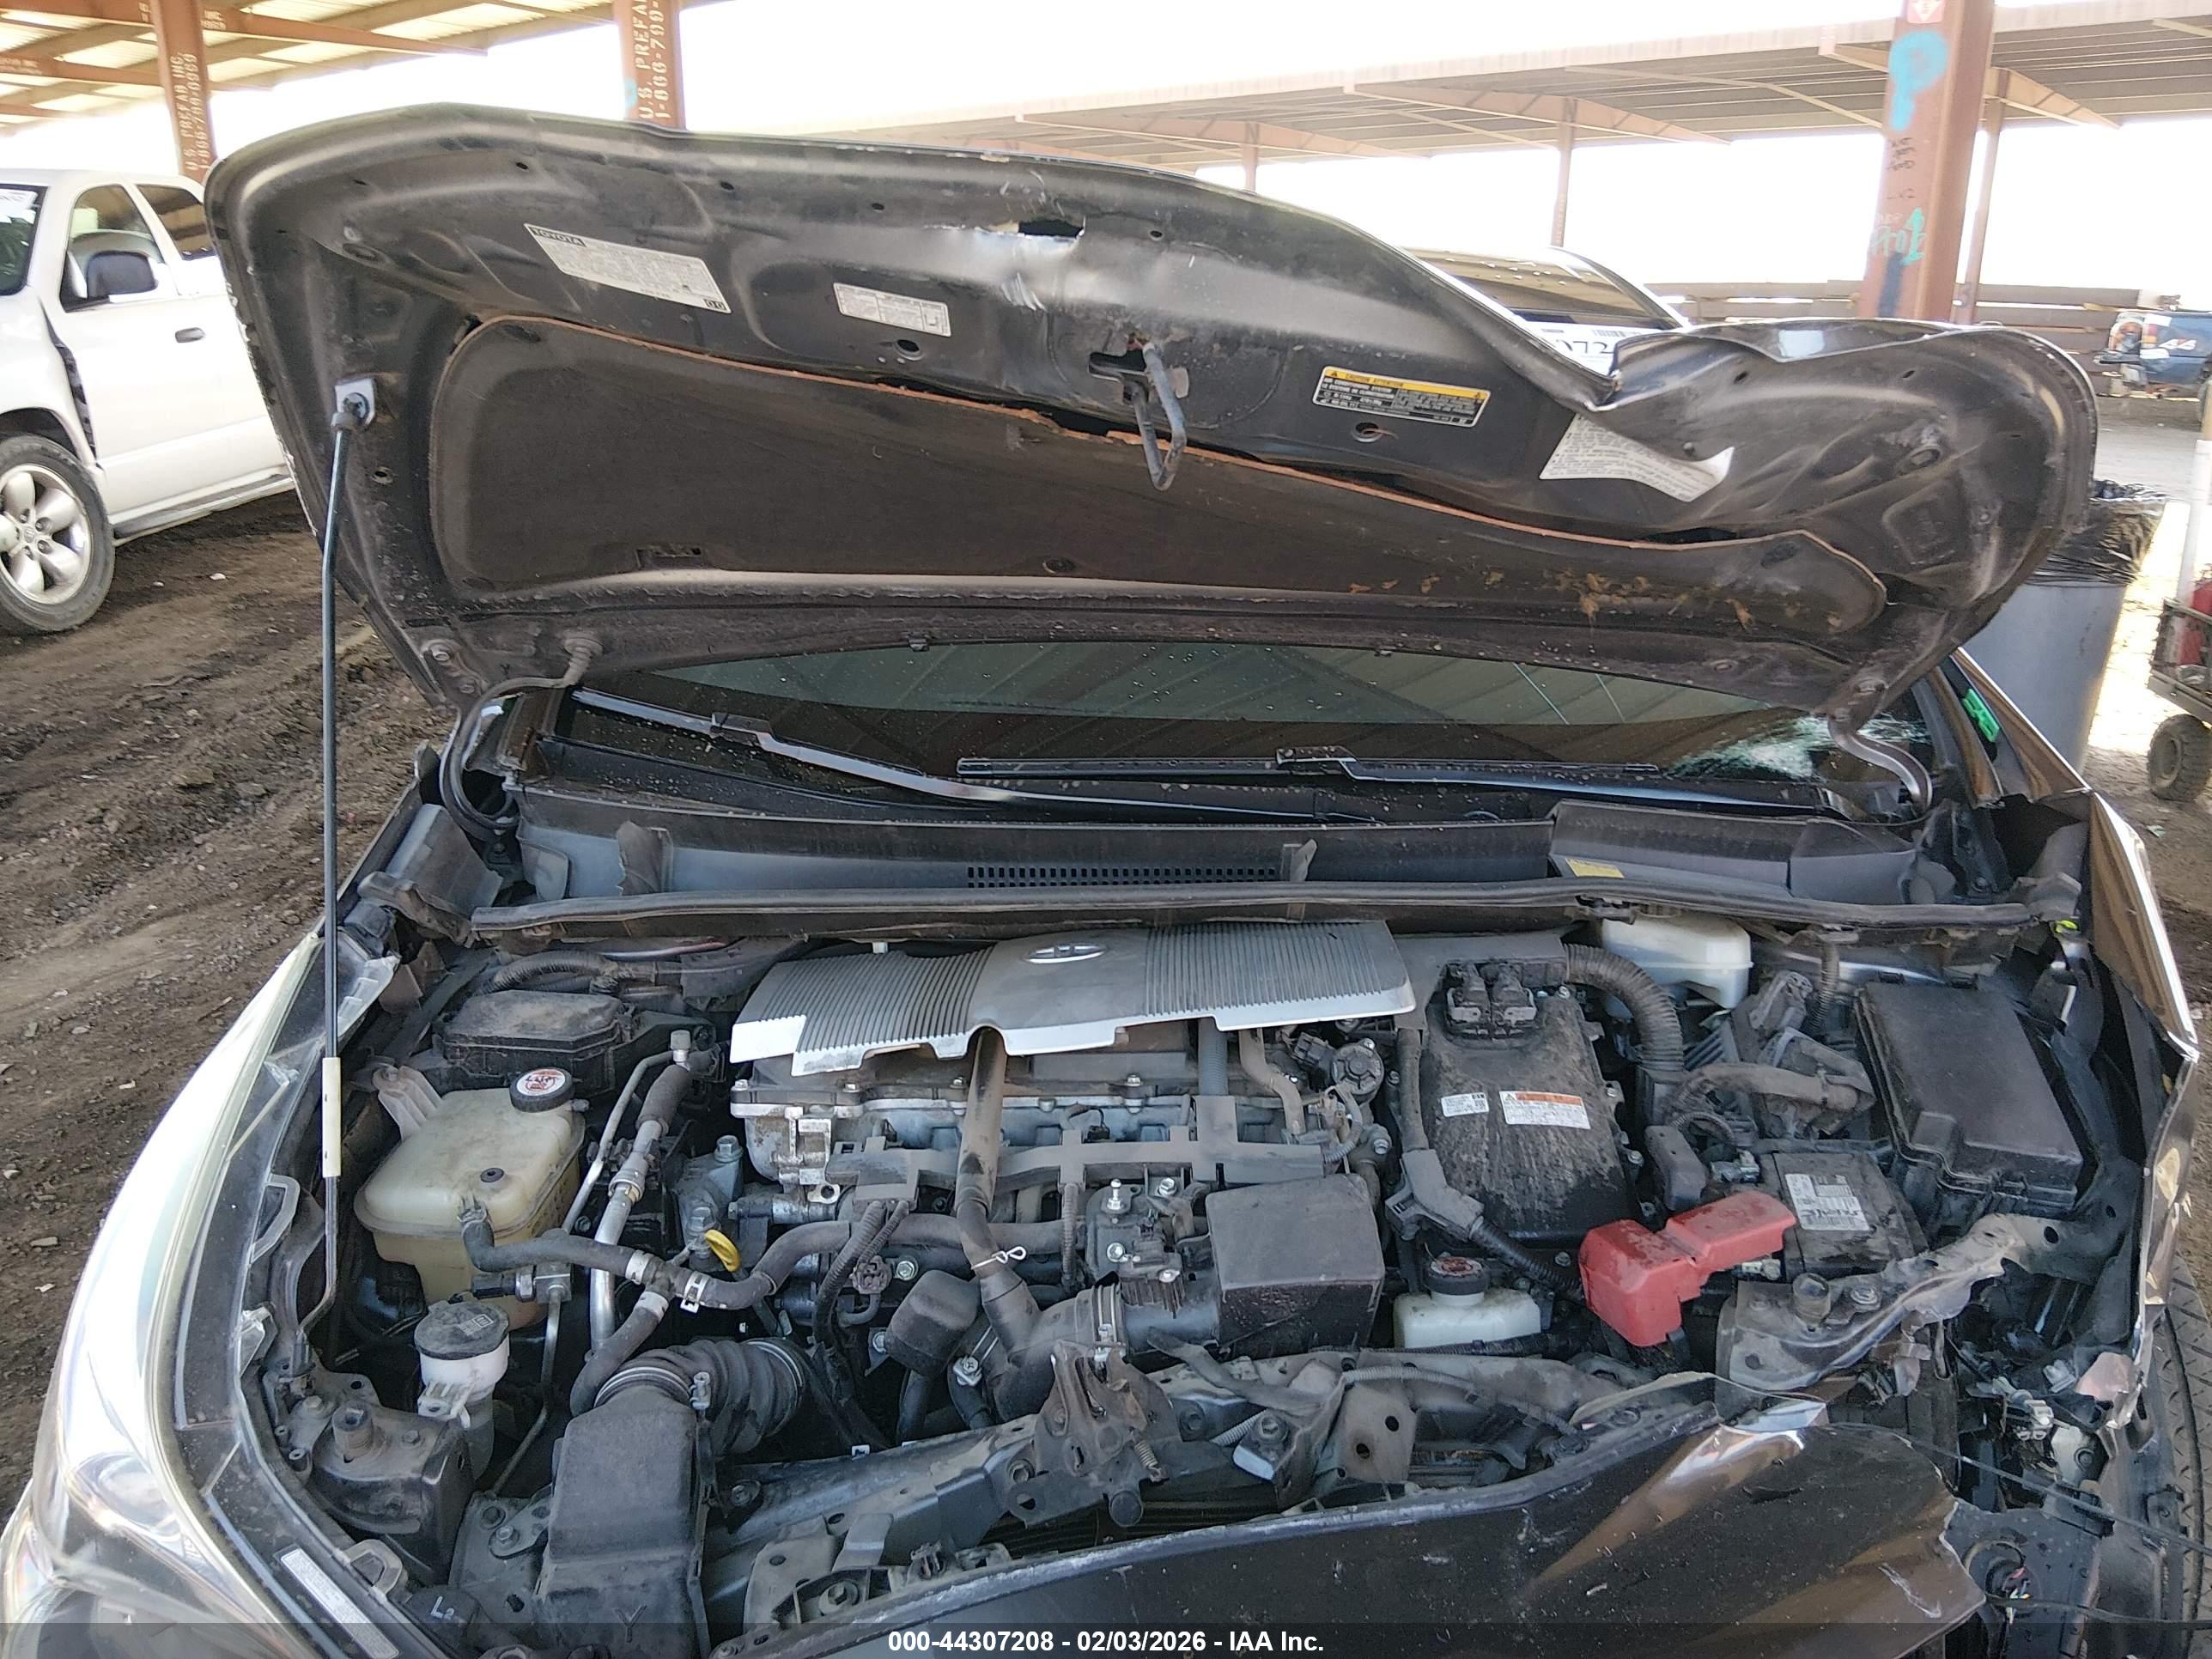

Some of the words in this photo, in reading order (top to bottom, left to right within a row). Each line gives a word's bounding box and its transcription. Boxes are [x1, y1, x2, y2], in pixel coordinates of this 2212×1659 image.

[631, 0, 651, 70] PREFA
[173, 84, 195, 138] PREFAB
[637, 81, 654, 118] U.S.
[532, 228, 586, 247] TOYOTA
